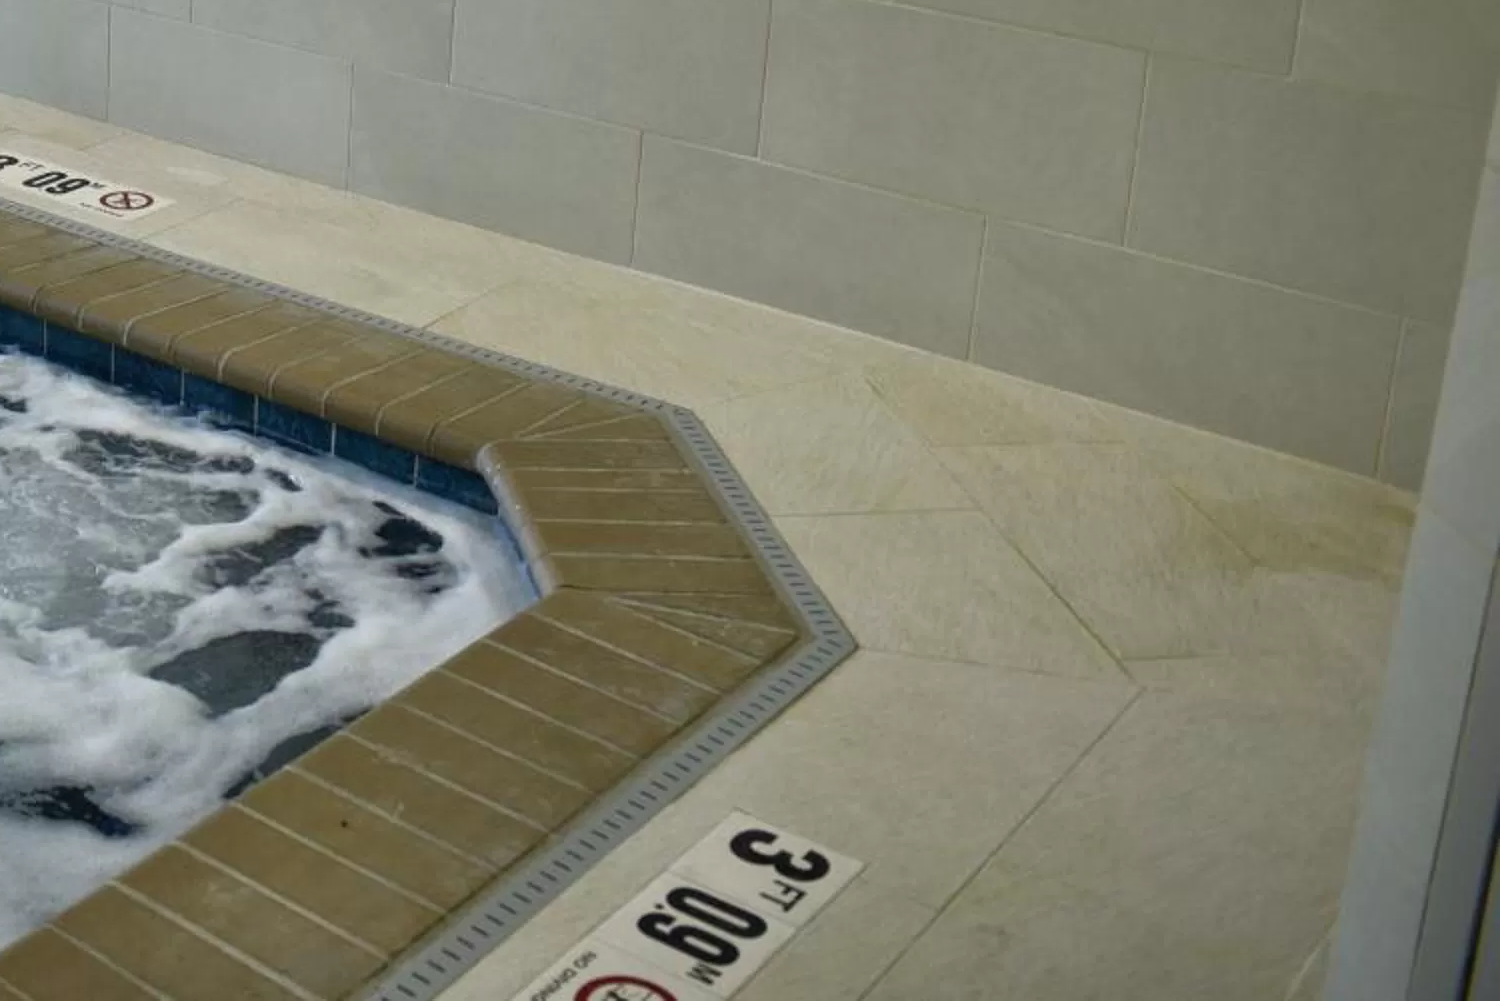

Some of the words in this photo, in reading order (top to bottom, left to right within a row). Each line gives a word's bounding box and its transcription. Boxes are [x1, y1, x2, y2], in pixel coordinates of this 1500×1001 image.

[729, 829, 831, 882] 3
[758, 879, 807, 913] FT
[685, 962, 723, 986] M
